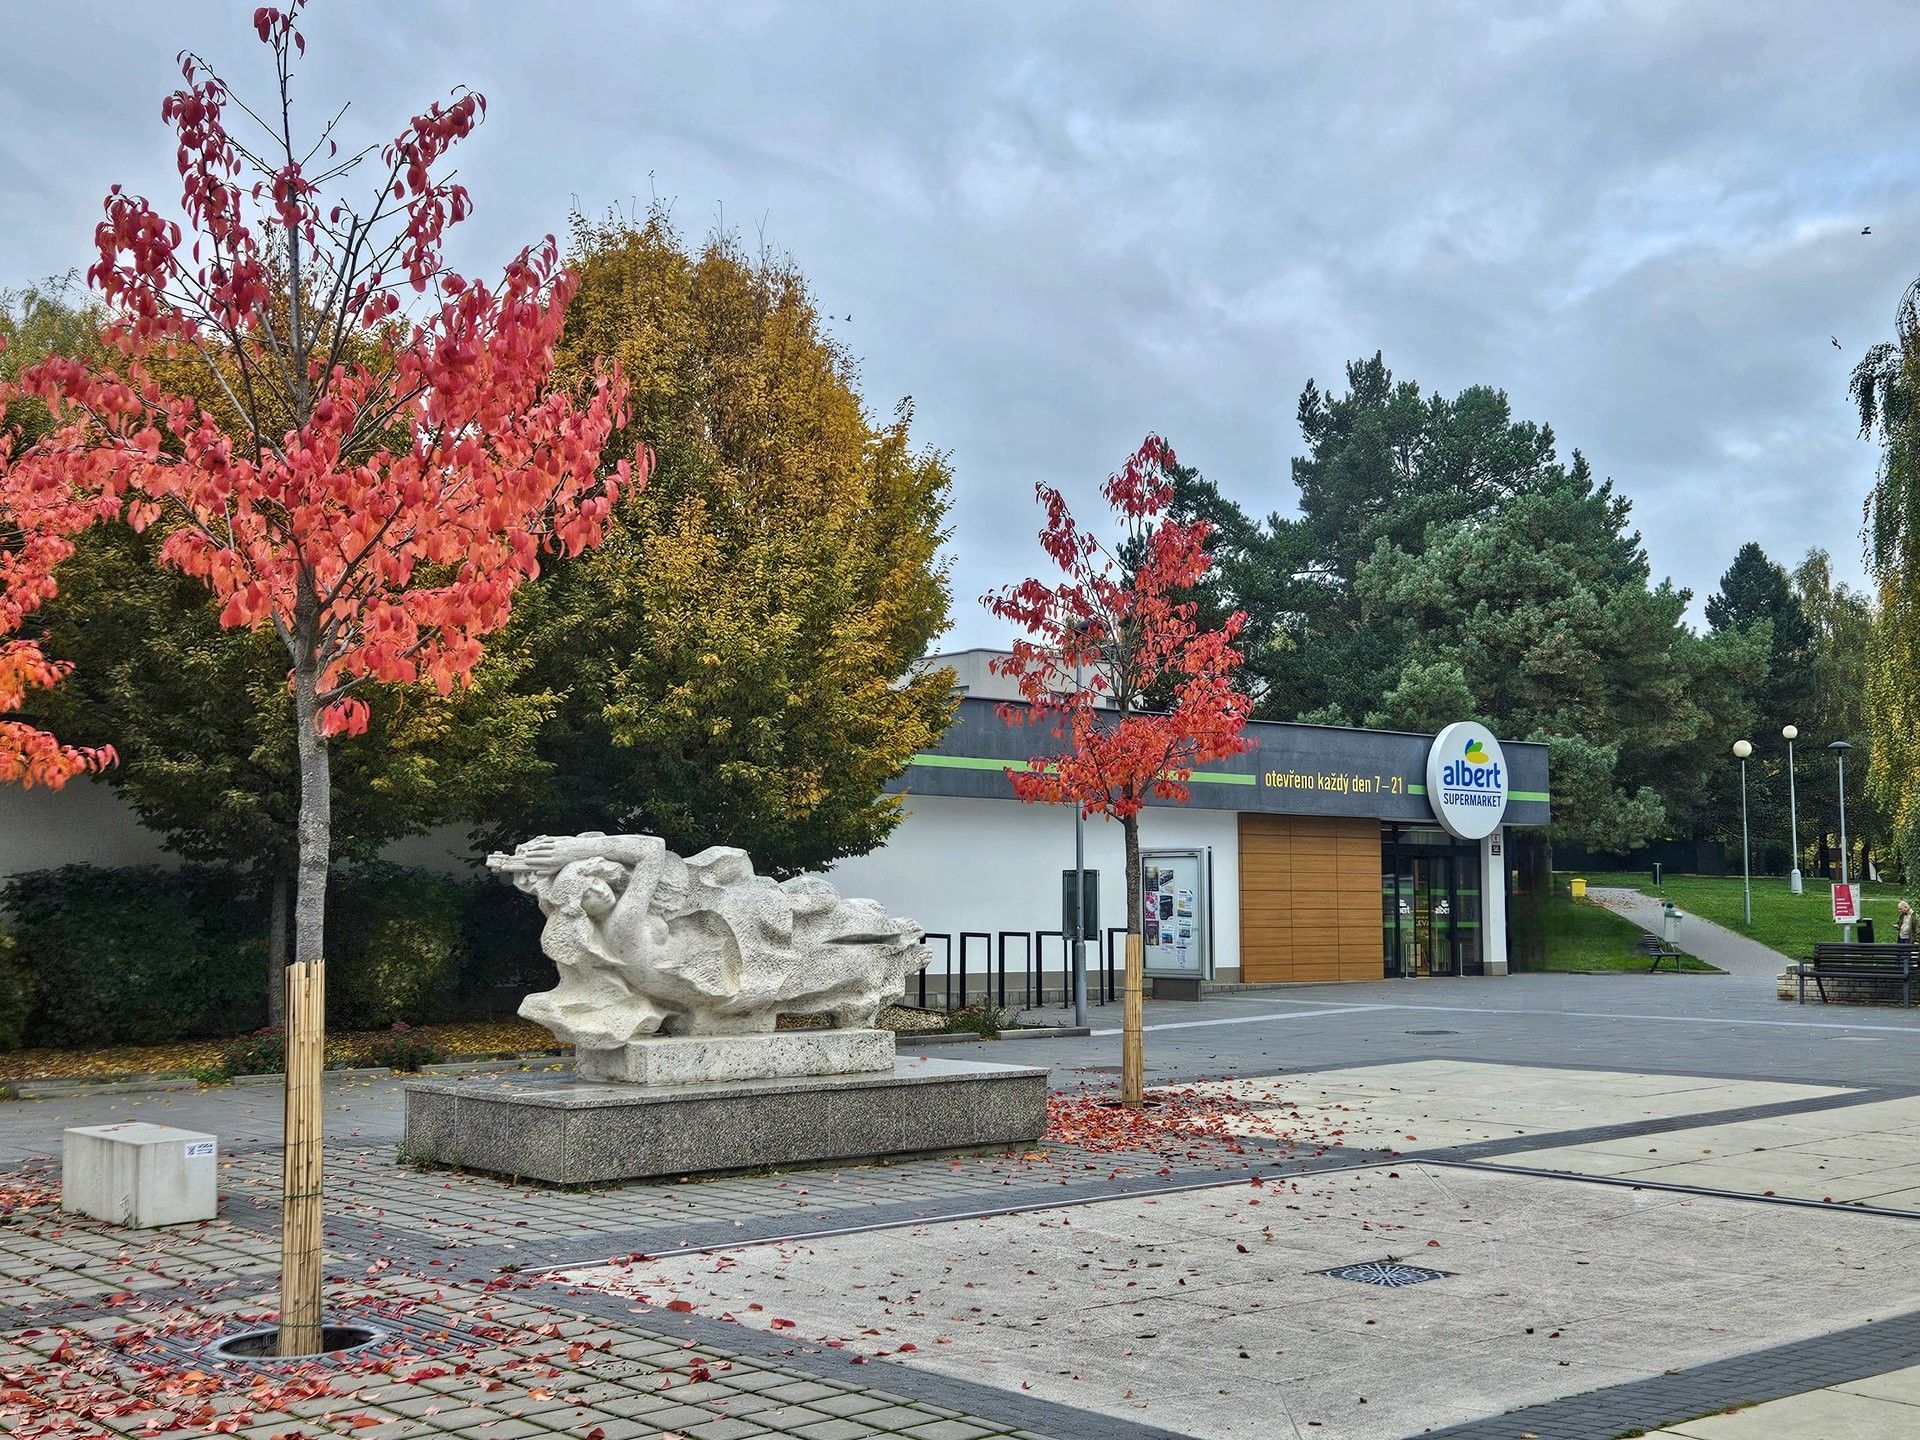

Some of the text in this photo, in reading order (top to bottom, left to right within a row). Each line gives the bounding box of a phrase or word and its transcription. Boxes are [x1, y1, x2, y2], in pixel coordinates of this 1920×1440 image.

[1265, 769, 1314, 789] otevřeno
[1318, 772, 1348, 795] každý
[1352, 775, 1371, 793] den
[1443, 760, 1501, 788] albert
[1443, 793, 1501, 807] SUPERMARKET
